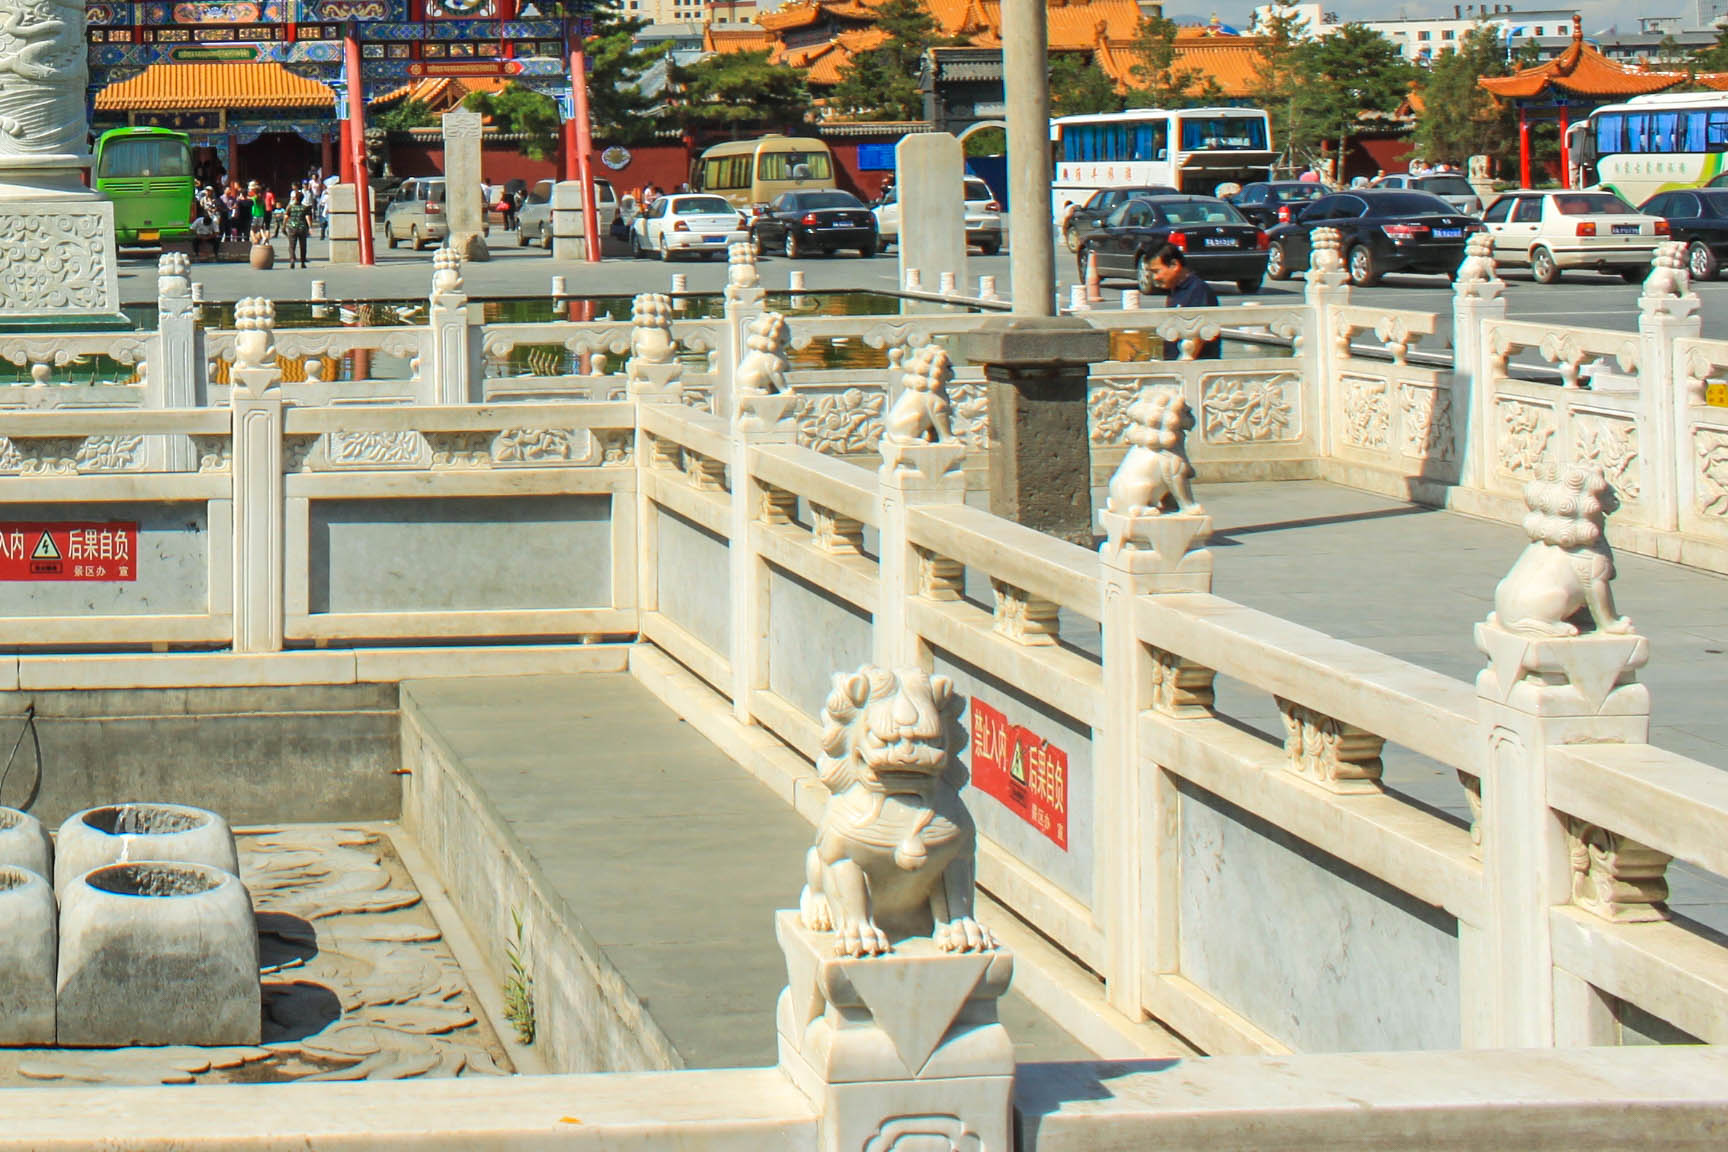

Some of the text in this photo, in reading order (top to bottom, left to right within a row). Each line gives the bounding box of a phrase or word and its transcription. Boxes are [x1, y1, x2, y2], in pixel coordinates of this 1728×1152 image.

[68, 528, 129, 561] 后果自负
[73, 564, 107, 577] 景区办
[974, 708, 1064, 814] 禁止入内 后果自负
